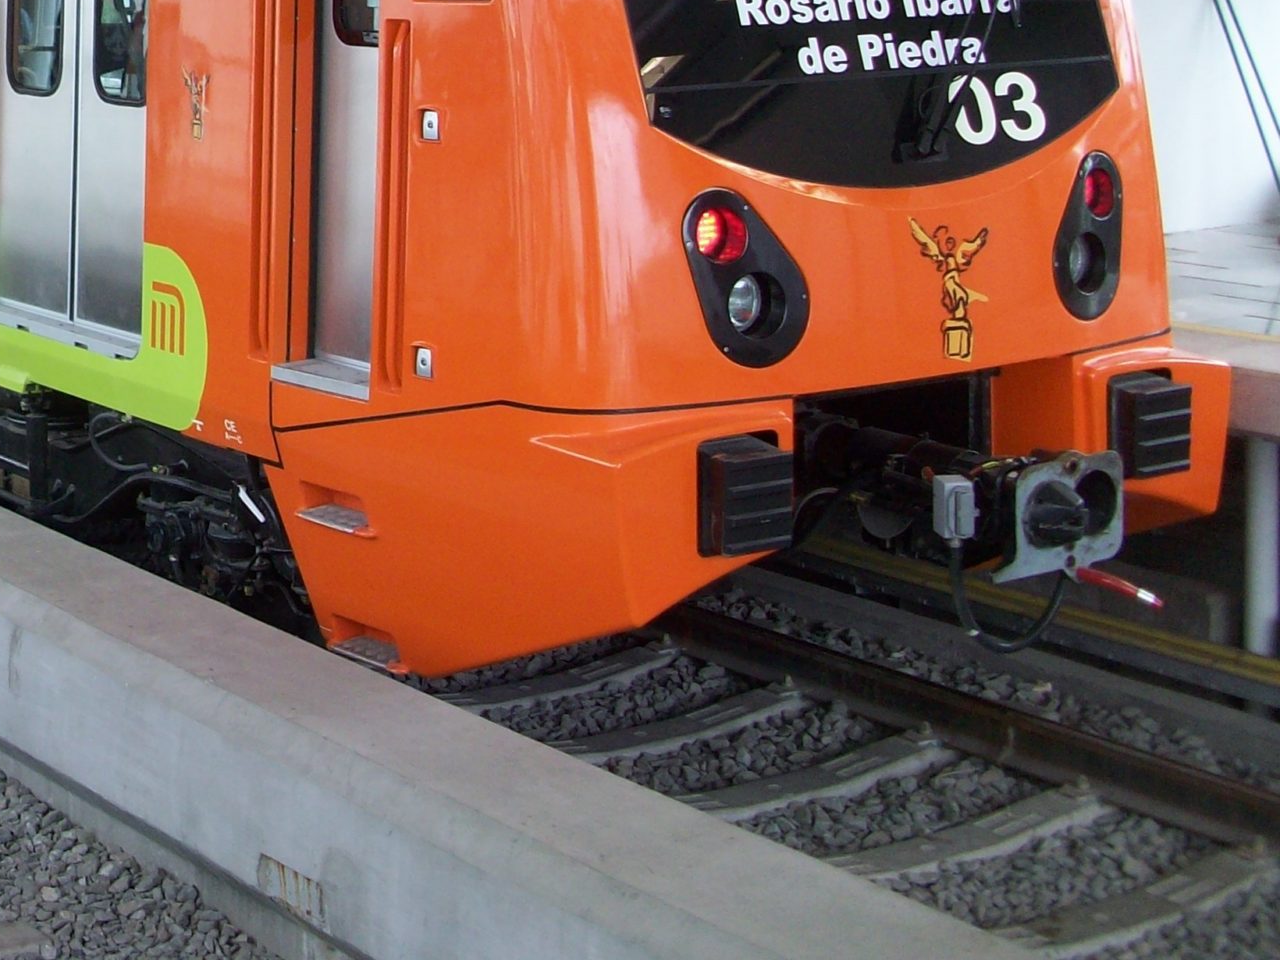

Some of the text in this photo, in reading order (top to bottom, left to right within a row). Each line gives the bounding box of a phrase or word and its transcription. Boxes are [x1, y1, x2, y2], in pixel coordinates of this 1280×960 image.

[797, 30, 986, 75] de Piedra
[948, 71, 1046, 146] 03
